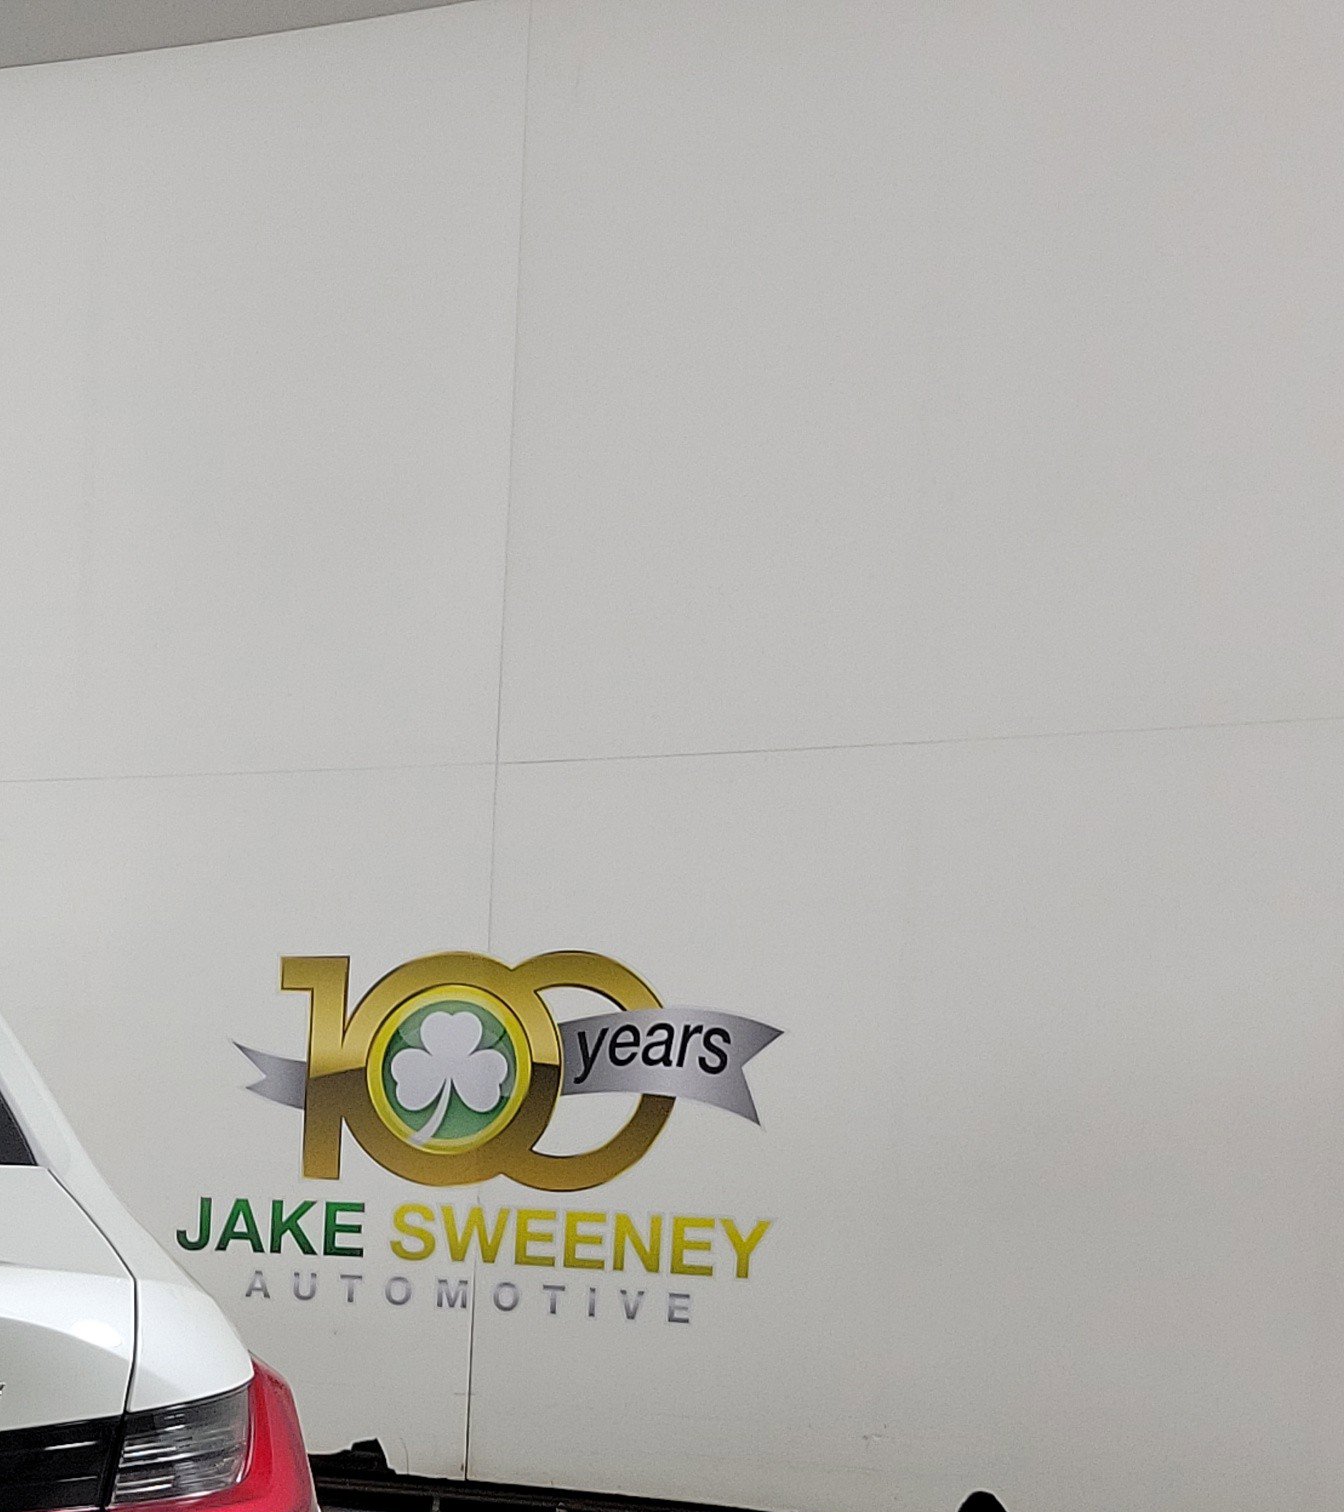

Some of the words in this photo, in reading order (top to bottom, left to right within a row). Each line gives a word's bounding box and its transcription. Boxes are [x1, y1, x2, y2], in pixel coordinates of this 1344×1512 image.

[280, 950, 676, 1192] 100
[573, 1022, 732, 1084] years
[175, 1197, 365, 1258] JAKE
[389, 1202, 772, 1280] SWEENEY
[245, 1269, 691, 1325] AUTOMOTIVE
